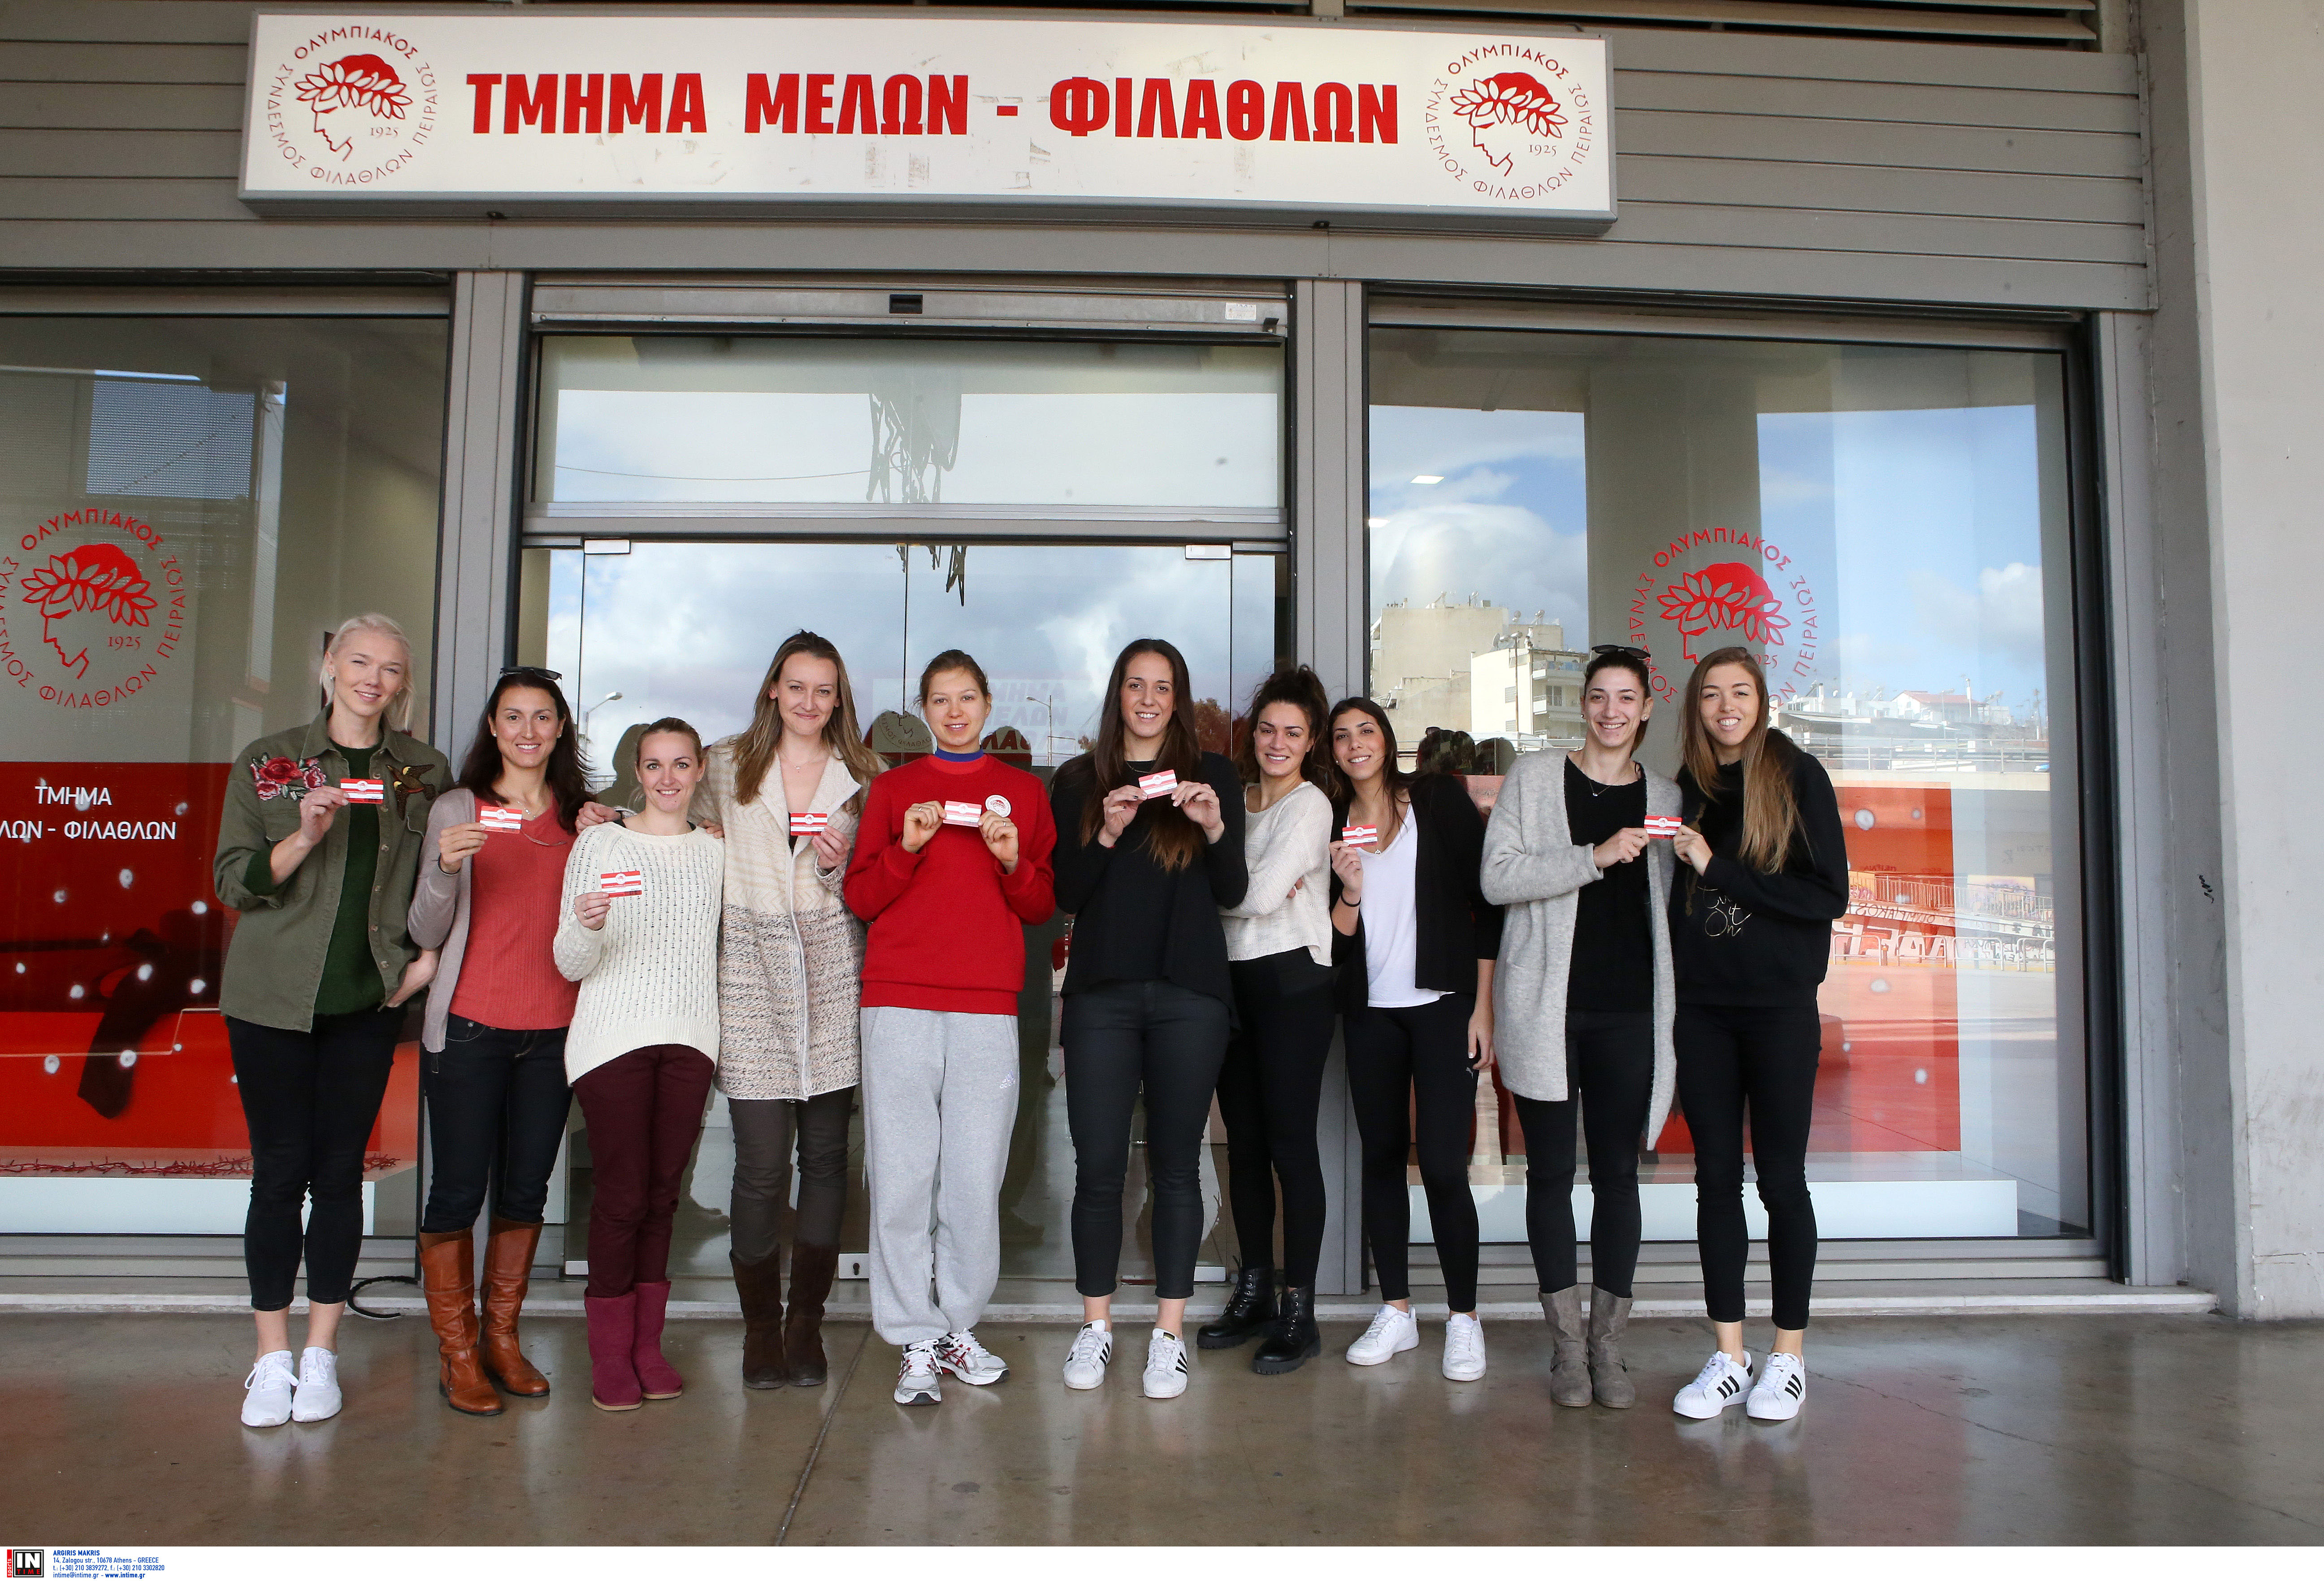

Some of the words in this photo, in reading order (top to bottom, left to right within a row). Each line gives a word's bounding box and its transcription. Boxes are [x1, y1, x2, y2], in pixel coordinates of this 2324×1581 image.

[295, 26, 418, 59] ΟΛΥΜΠΙΑΚΟΣ
[1448, 44, 1569, 79] ΟΛΥΜΠΙΑΚΟΣ
[268, 64, 306, 169] ΣΥΝΔΕΣΜΟΣ
[311, 148, 413, 185] ΦΙΛΑΘΛΩΝ
[412, 61, 438, 145] ΠΕΙΡΑΙΩΣ
[467, 73, 707, 134] ΤΜΗΜΑ
[745, 74, 968, 134] ΜΕΛΩΝ
[997, 106, 1018, 116] -
[1050, 77, 1397, 144] ΦΙΛΑΘΛΩΝ
[370, 127, 399, 139] 1925
[1426, 78, 1468, 182] ΣΥΝΔΕΣΜΟΣ
[1474, 167, 1573, 200] ΦΙΛΑΘΛΩΝ
[1568, 83, 1592, 164] ΠΕΙΡΑΙΩΣ
[1529, 144, 1557, 157] 1925
[21, 508, 164, 551] ΟΛΥΜΠΙΑΚΟΣ
[1653, 528, 1792, 571] ΟΛΥΜΠΙΑΚΟΣ
[39, 664, 157, 708] ΦΙΛΑΘΛΩΝ
[157, 554, 186, 658] ΠΕΙΡΑΙΩΣ
[108, 635, 141, 650] 1925
[1790, 575, 1819, 677] ΠΕΙΡΑΙΩΣ
[1753, 654, 1778, 669] 925
[991, 682, 1066, 702] ΜΗΜΑ
[985, 706, 1068, 726] ΕΛΩΝ
[35, 786, 112, 805] ΤΜΗΜΑ
[0, 820, 42, 839] ΛΩΝ
[64, 821, 176, 840] ΦΙΛΑΘΛΩΝ
